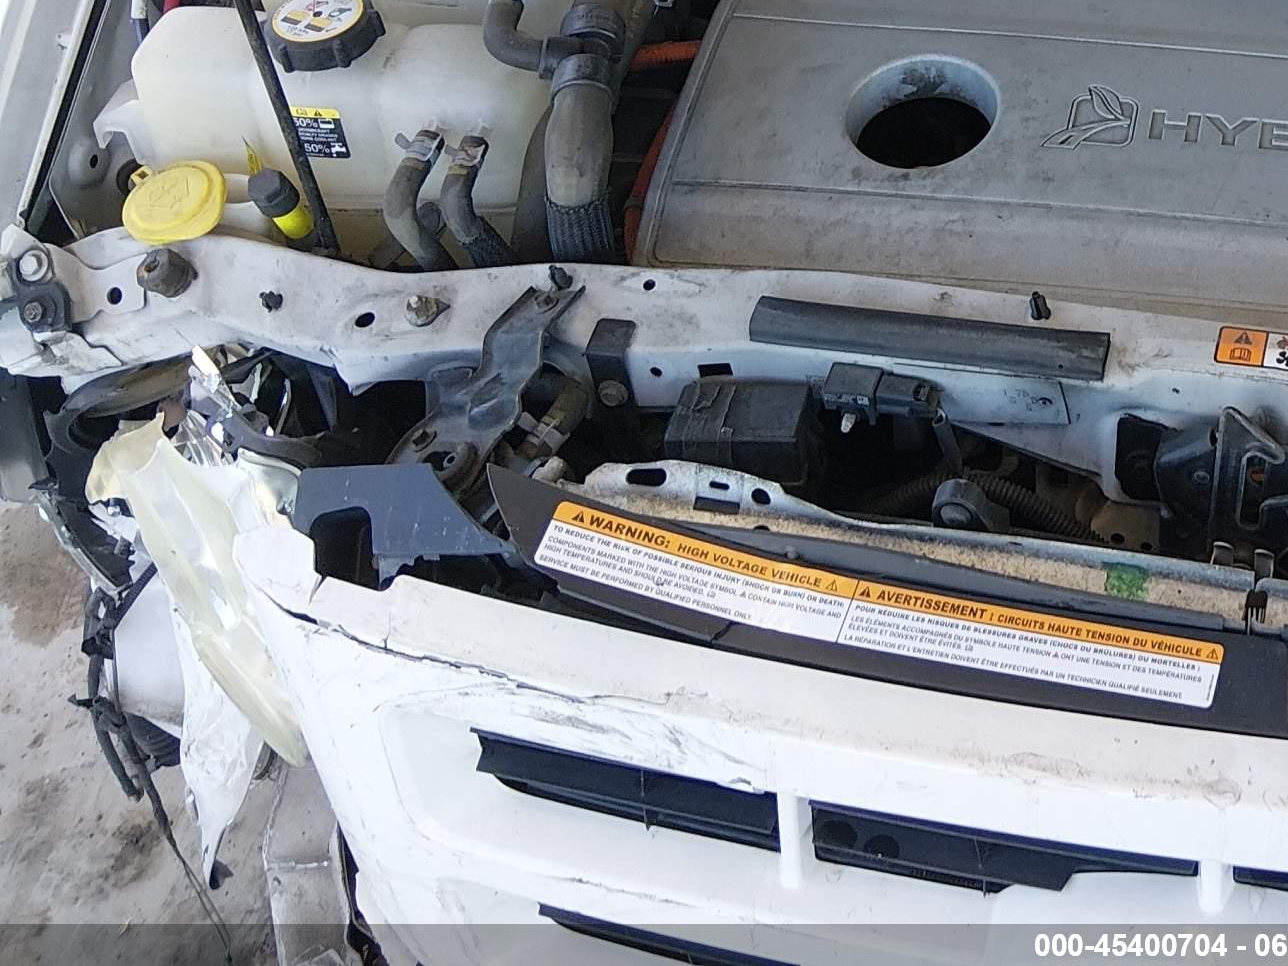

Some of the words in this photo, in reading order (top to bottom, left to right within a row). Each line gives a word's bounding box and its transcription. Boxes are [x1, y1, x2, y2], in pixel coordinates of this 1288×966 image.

[304, 143, 330, 153] 50%
[544, 544, 561, 554] HIGH
[562, 548, 617, 570] TEMPERATURES
[618, 565, 633, 575] AND
[548, 536, 596, 554] COMPONENTS
[597, 549, 626, 563] MARKED
[627, 560, 644, 568] WITH
[646, 565, 658, 573] THE
[660, 568, 676, 578] HIGH
[678, 572, 709, 588] VOLTAGE
[709, 582, 737, 595] SYMBOL
[795, 603, 826, 616] VOLTAGE
[827, 611, 841, 619] AND
[554, 525, 563, 533] TO
[565, 527, 594, 543] REDUCE
[597, 538, 611, 547] THE
[613, 544, 629, 553] RISK
[643, 552, 679, 566] POSSIBLE
[680, 563, 712, 576] SERIOUS
[713, 571, 741, 584] INJURY
[771, 587, 782, 595] OR
[589, 514, 671, 548] WARNING:
[677, 543, 709, 560] HIGH
[713, 554, 768, 575] VOLTAGE
[771, 570, 822, 587] VEHICLE
[540, 554, 569, 568] SERVICE
[570, 564, 590, 574] MUST
[591, 569, 600, 577] BE
[601, 572, 644, 589] PERFORMED
[644, 585, 654, 593] BY
[655, 588, 691, 603] QUALIFIED
[691, 600, 732, 615] PERSONNEL
[855, 605, 876, 614] POUR
[878, 608, 909, 621] RÉDUIRE
[876, 589, 987, 619] AVERTISSEMENT
[998, 614, 1045, 630] CIRCUITS
[1048, 620, 1082, 636] HAUTE
[1086, 628, 1130, 644] TENSION
[1133, 637, 1148, 647] DU
[1151, 640, 1202, 657] VÉHICULE
[889, 631, 918, 643] DOIVENT
[851, 616, 864, 624] LES
[998, 643, 1020, 652] HAUTE
[1022, 646, 1051, 657] TENSION
[1077, 656, 1090, 665] UNE
[1092, 659, 1121, 670] TENSION
[951, 653, 980, 664] DOIVENT
[1040, 669, 1054, 677] PAR
